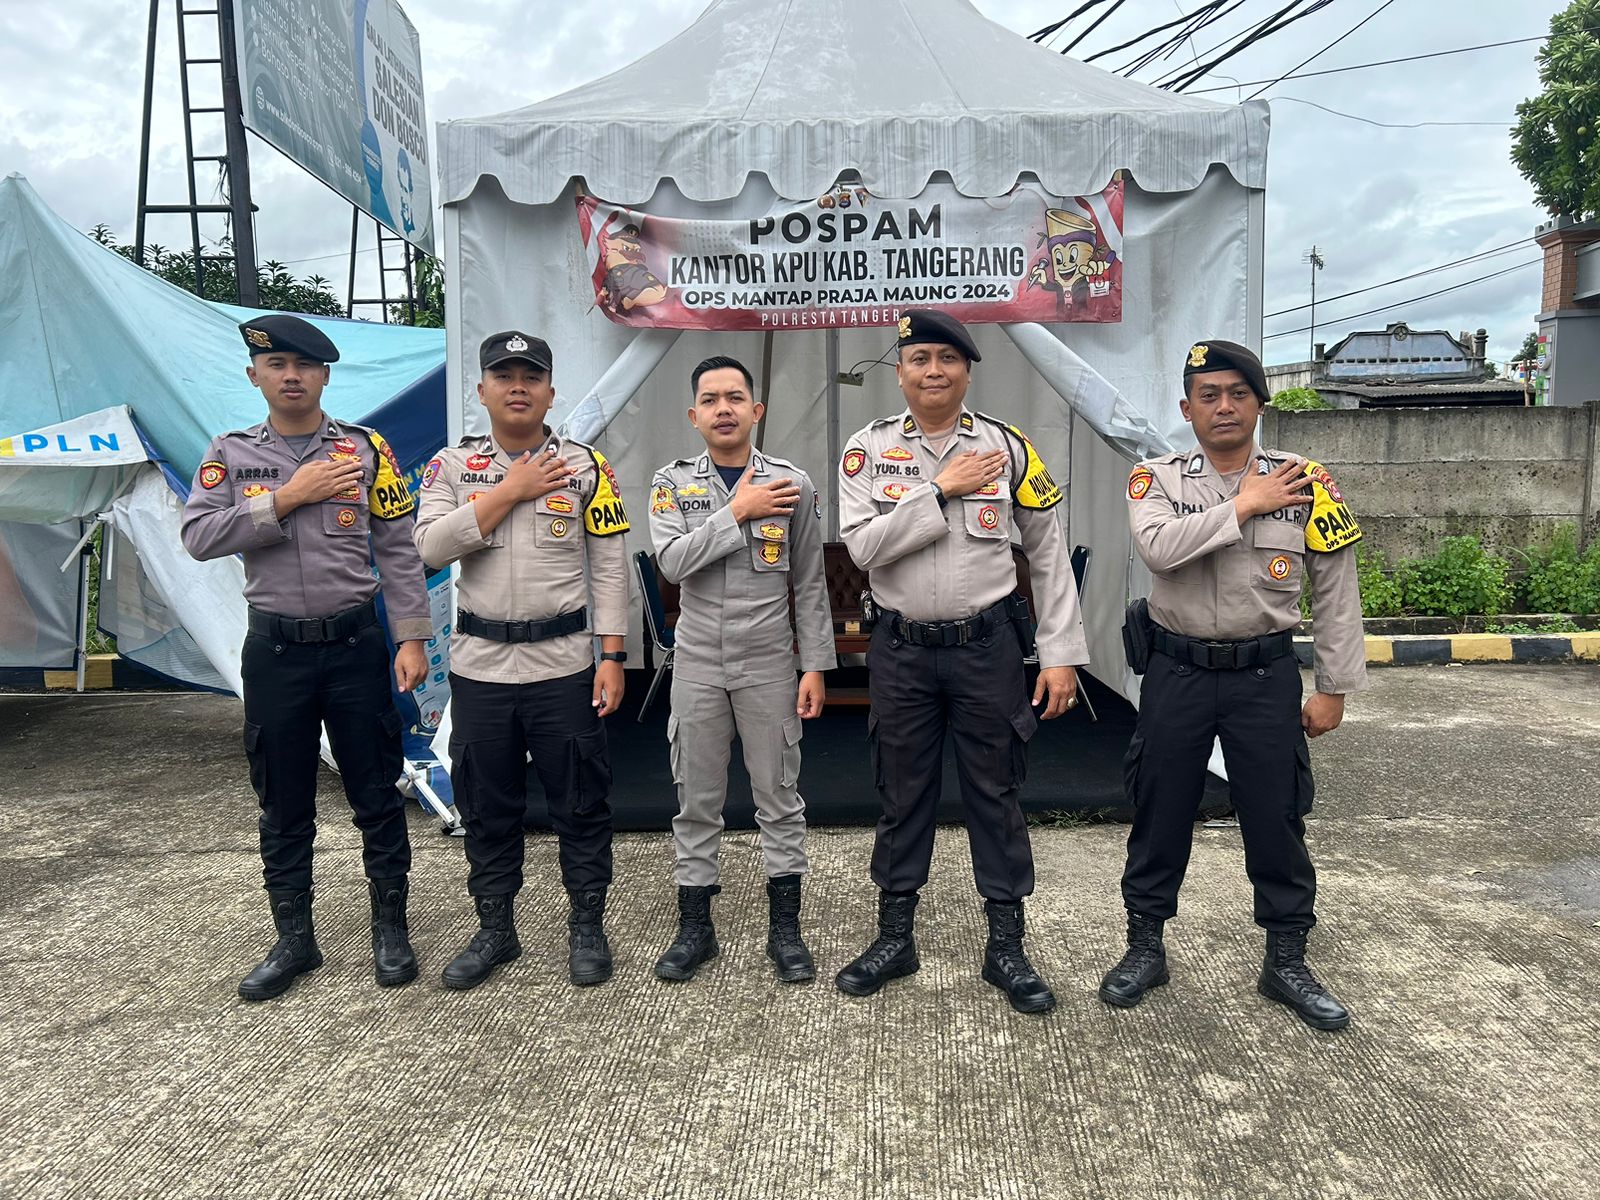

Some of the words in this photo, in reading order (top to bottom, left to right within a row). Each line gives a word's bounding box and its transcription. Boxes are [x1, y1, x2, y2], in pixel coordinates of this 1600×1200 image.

[374, 54, 421, 130] SALESIAN
[371, 86, 396, 138] DON
[395, 111, 426, 166] BOSCO
[750, 203, 941, 245] POSPAM
[671, 253, 766, 285] KANTOR
[773, 251, 817, 283] KPU
[823, 250, 875, 282] KAB.
[882, 246, 1024, 279] TANGERANG
[685, 290, 725, 305] OPS
[731, 289, 812, 306] MANTAP
[817, 287, 878, 304] PRAJA
[883, 284, 957, 301] MAUNG
[962, 283, 1010, 299] 2024
[761, 310, 836, 327] POLRESTA
[841, 308, 904, 324] TANGER
[22, 432, 121, 453] PLN
[235, 467, 280, 481] ARRAS
[875, 463, 903, 476] YUDI.
[905, 465, 920, 477] SG
[591, 500, 628, 531] PAM
[682, 499, 711, 511] DOM
[1313, 504, 1356, 542] PAM
[1325, 538, 1340, 550] OPS
